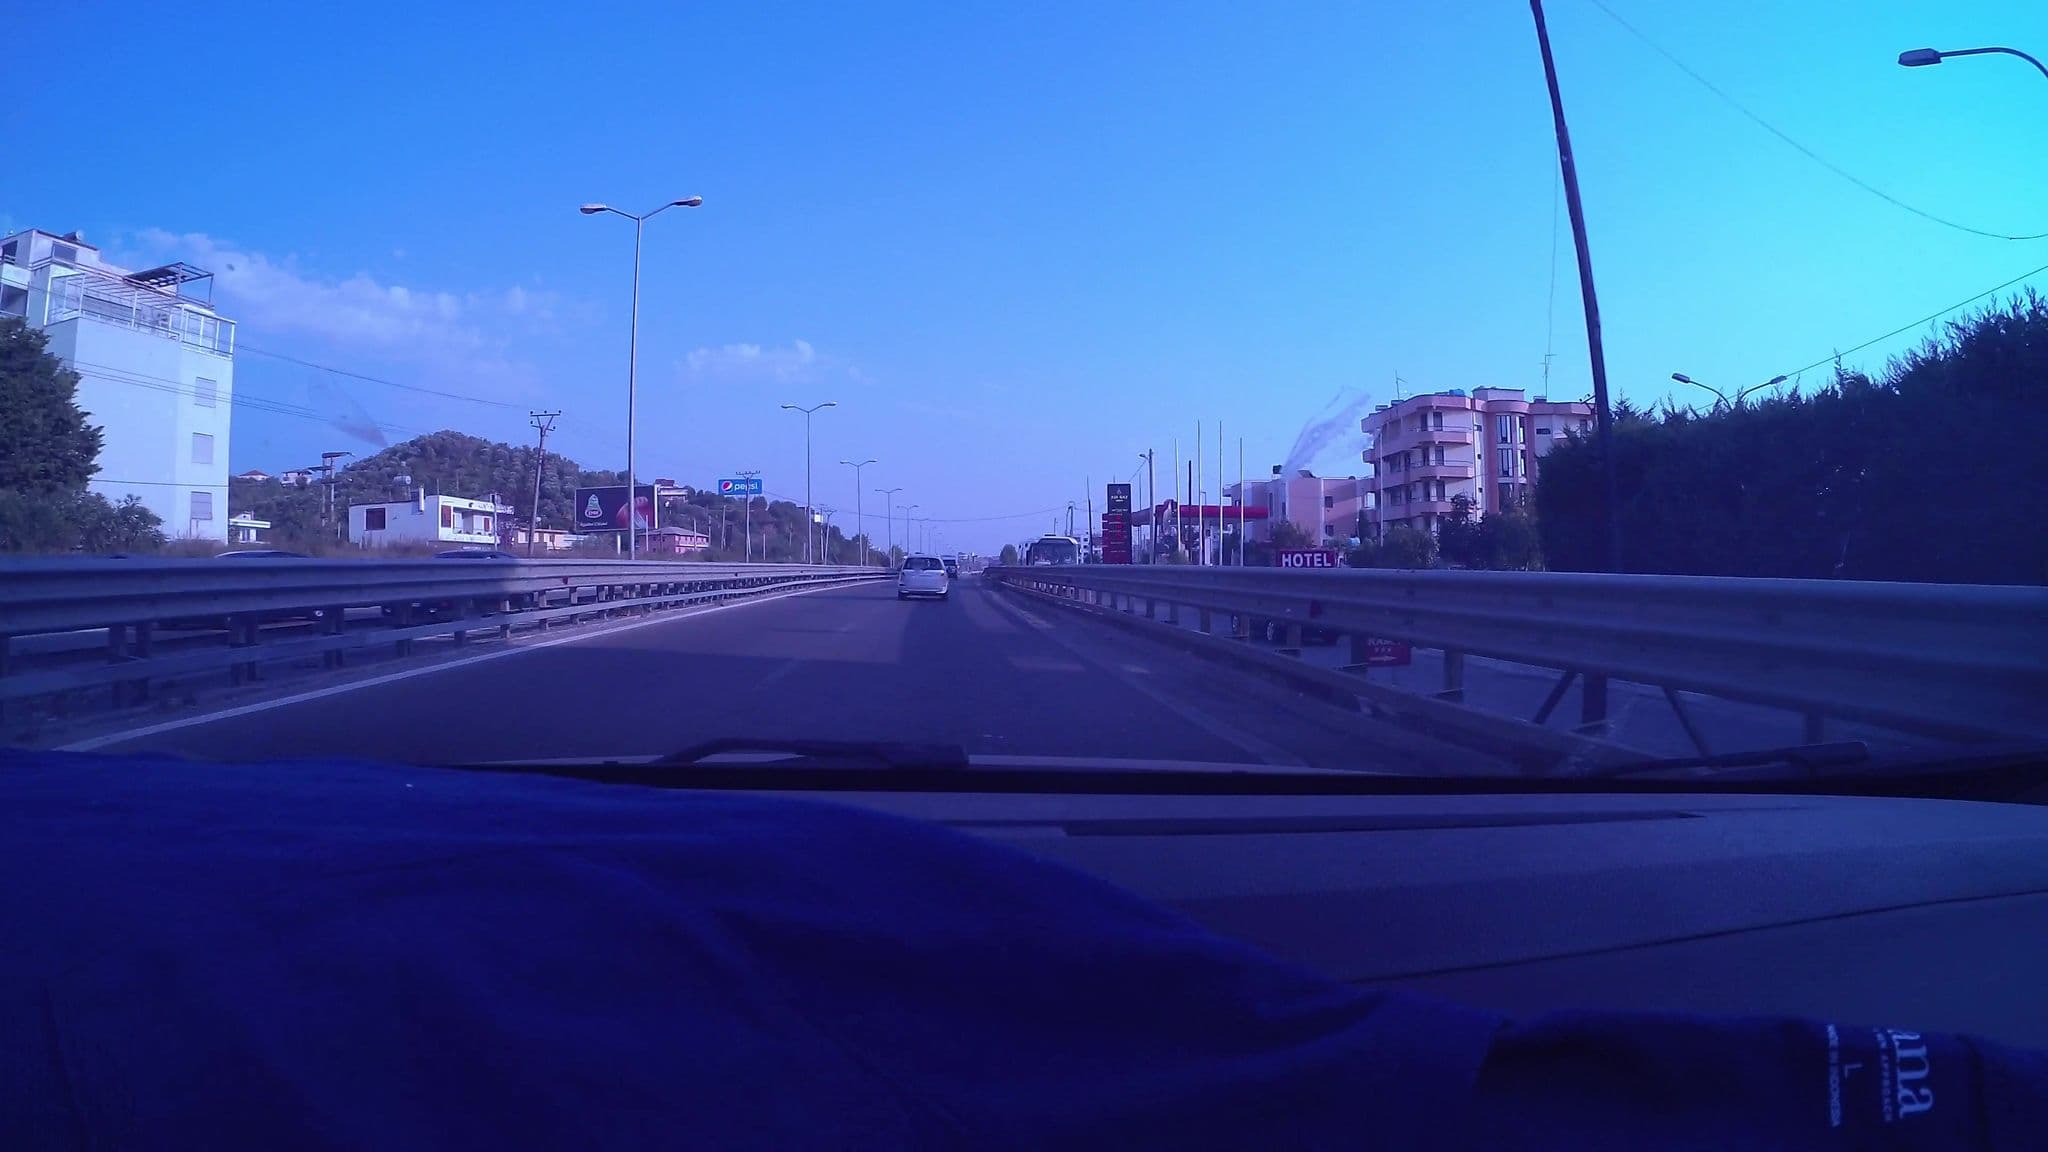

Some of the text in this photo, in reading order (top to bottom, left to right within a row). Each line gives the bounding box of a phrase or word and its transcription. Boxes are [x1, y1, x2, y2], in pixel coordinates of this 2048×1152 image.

[1282, 553, 1332, 568] HOTEL
[1844, 1063, 1863, 1080] L
[1829, 1065, 1841, 1128] INDONESIA
